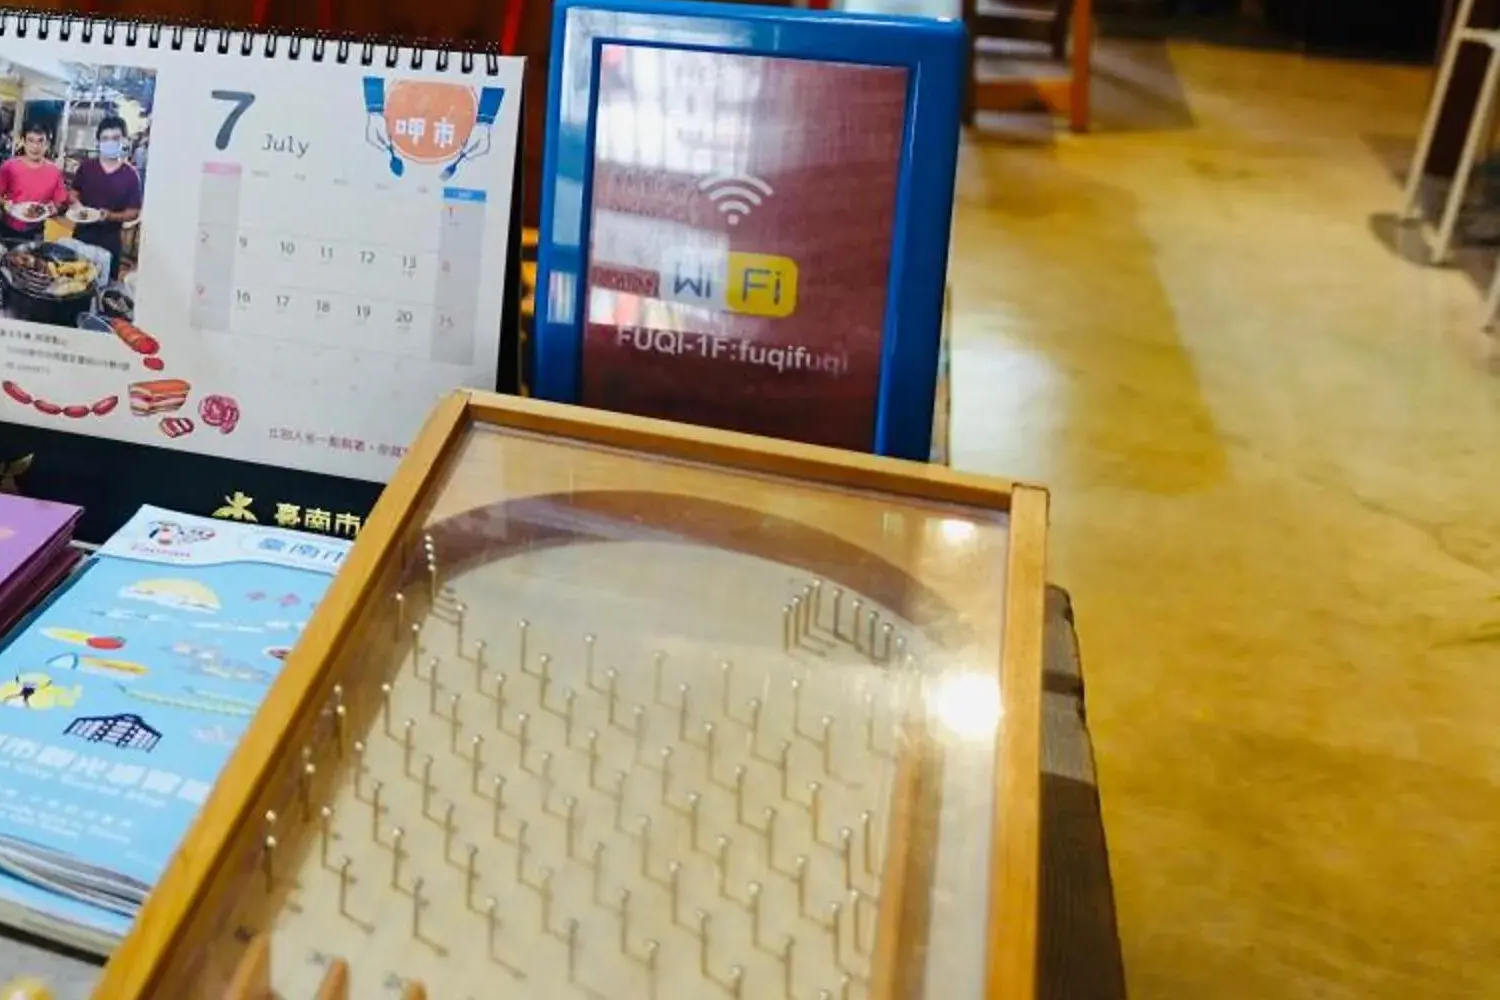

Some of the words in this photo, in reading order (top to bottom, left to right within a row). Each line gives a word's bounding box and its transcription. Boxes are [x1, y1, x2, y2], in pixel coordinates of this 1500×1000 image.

[211, 90, 256, 150] 7
[395, 117, 455, 148] 呷市
[261, 134, 311, 157] July
[280, 240, 295, 255] 10
[320, 246, 334, 259] 11
[360, 250, 376, 264] 12
[402, 255, 417, 269] 13
[741, 267, 783, 306] Fi
[236, 288, 251, 303] 16
[276, 295, 290, 308] 17
[316, 299, 330, 313] 18
[357, 305, 371, 319] 19
[396, 310, 413, 324] 20
